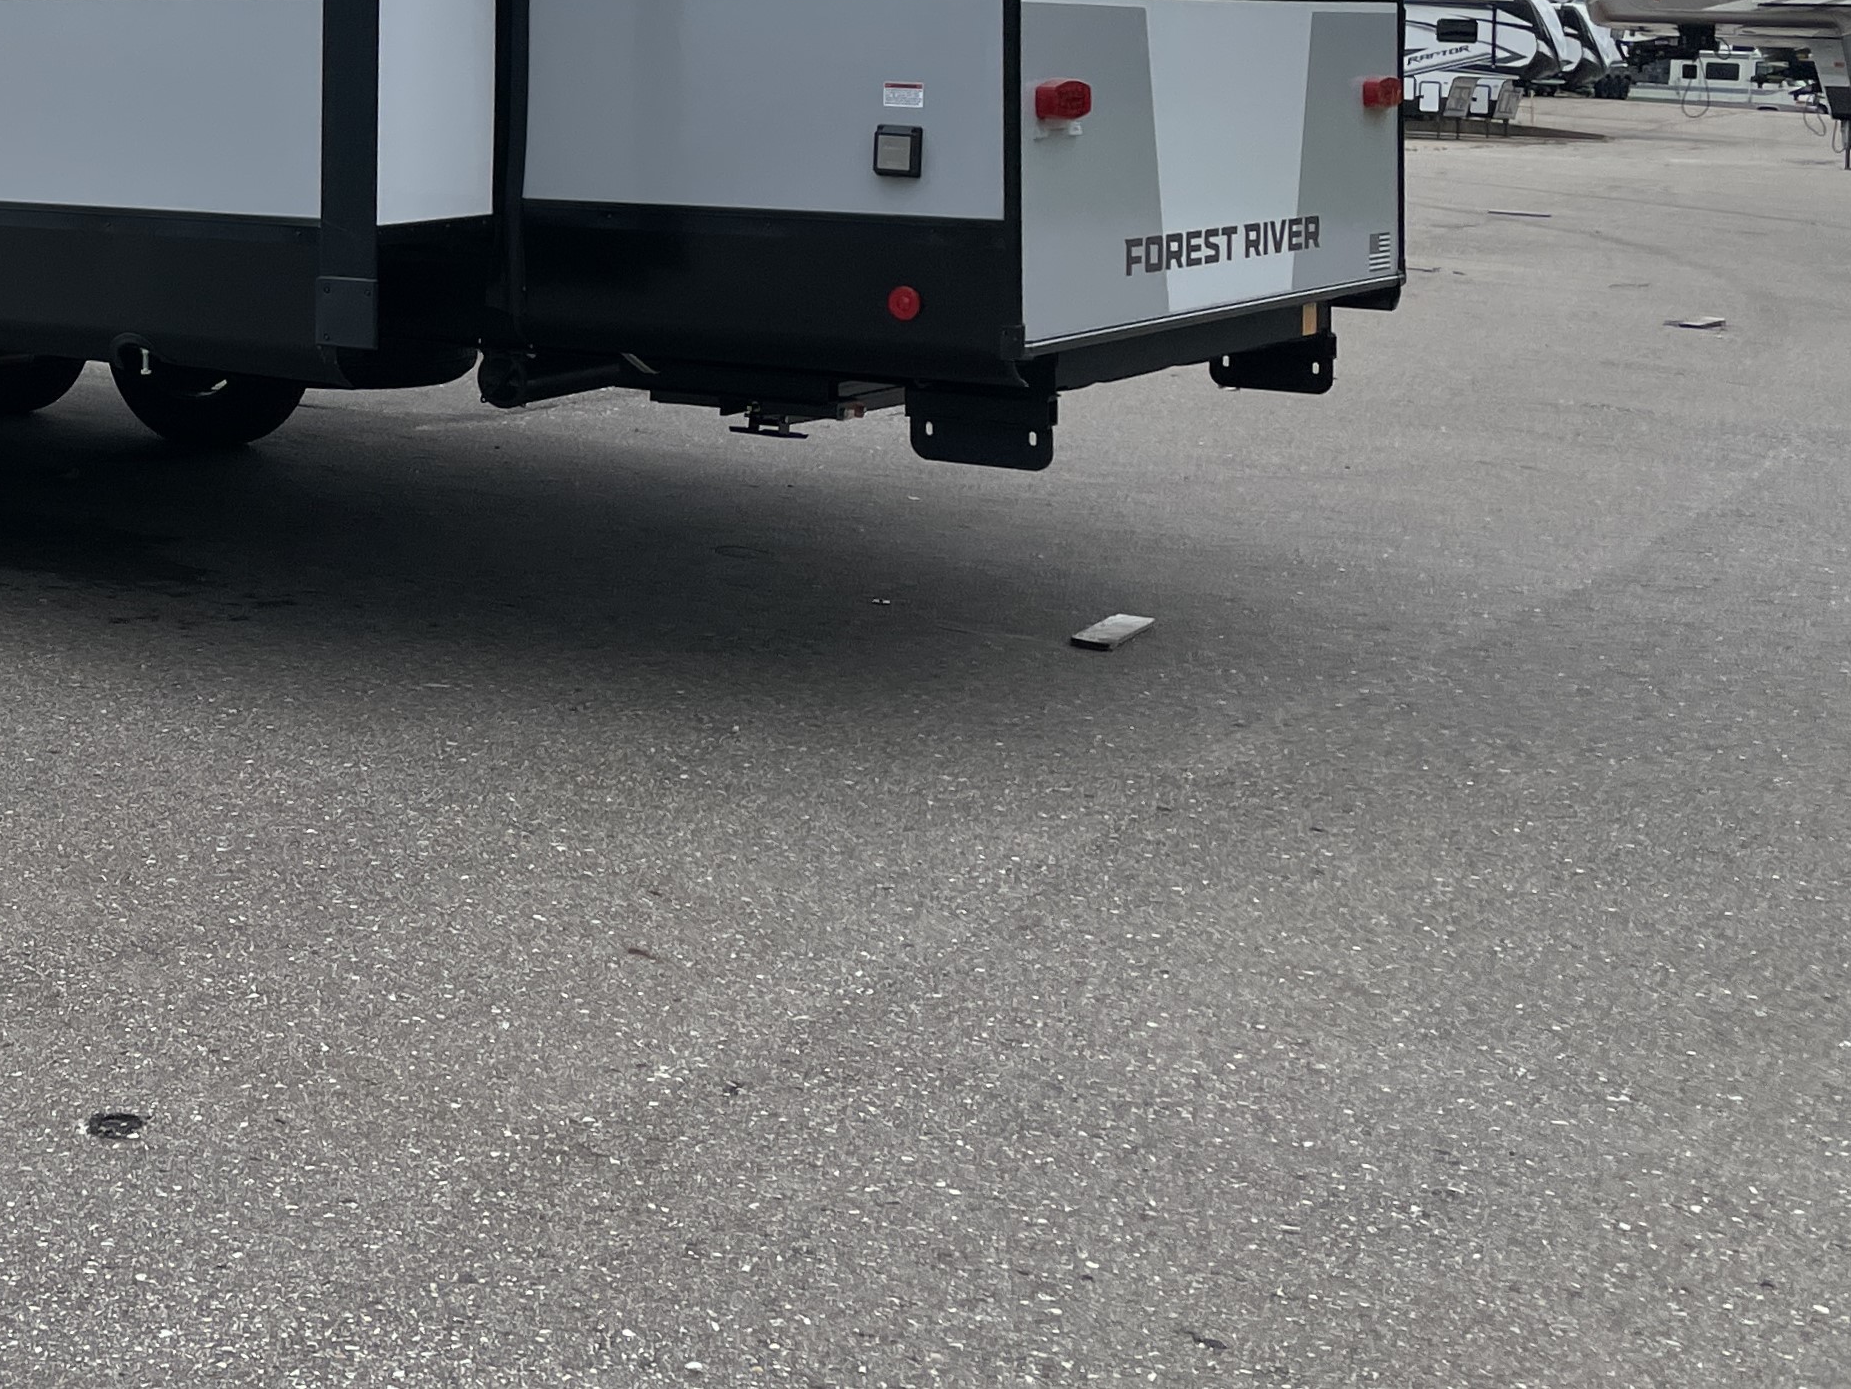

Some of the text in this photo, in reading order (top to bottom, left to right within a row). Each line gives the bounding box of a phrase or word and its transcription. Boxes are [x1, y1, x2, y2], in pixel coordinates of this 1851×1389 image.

[1406, 45, 1471, 67] RAPTOR
[1124, 215, 1321, 277] FOREST RIVER
